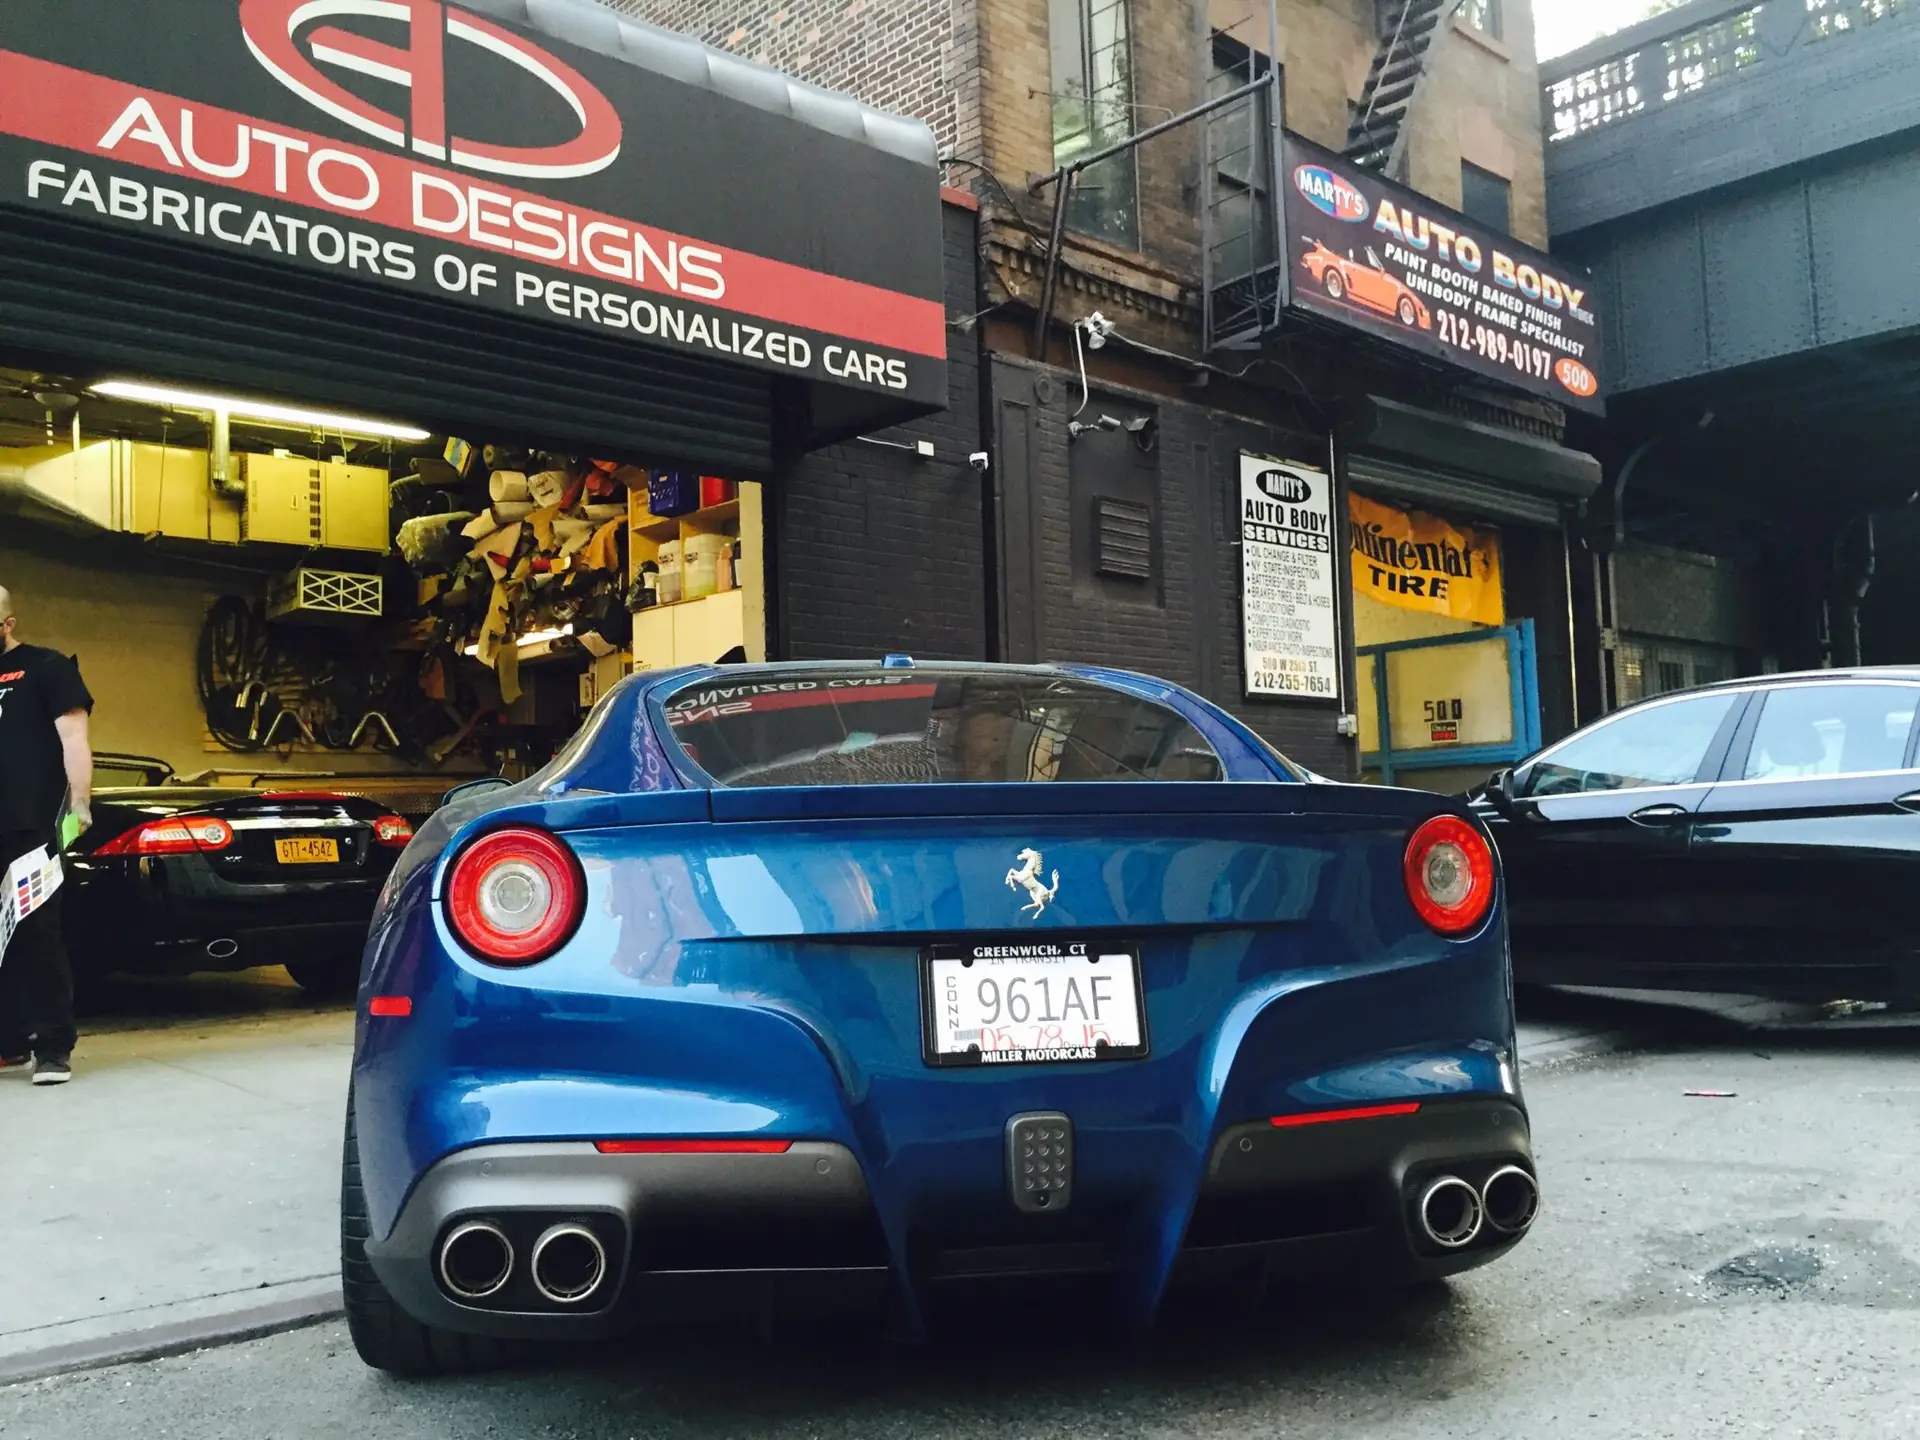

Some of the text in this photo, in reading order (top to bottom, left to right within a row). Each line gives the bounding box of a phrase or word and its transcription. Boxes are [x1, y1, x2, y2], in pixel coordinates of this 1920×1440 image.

[98, 97, 725, 300] AUTO DESIGNS
[1299, 169, 1364, 216] MARTY'S
[28, 160, 907, 390] FABRICATORS OF PERSONALIZED CARS
[1373, 199, 1482, 273] AUTO
[1493, 250, 1584, 318] BODY
[1385, 242, 1562, 331] PAINT BOOTH BAKED FINISH
[1406, 271, 1585, 357] UNIBODY FRAME SPECIALIST
[1437, 309, 1551, 380] 212-989-0197
[1562, 362, 1589, 392] 500
[1266, 472, 1304, 500] MARTY'S
[1245, 499, 1327, 533] AUTO BODY
[1244, 524, 1329, 552] SERVICES
[1263, 547, 1290, 562] CHANGE
[1368, 564, 1449, 600] TIRE
[1262, 656, 1277, 671] 500
[1280, 658, 1287, 671] W
[1254, 671, 1331, 693] 212-255-7654
[1424, 698, 1462, 722] 500
[973, 944, 1087, 957] GREENWICH, CT
[977, 976, 1112, 1025] 961AF
[981, 1047, 1096, 1062] MILLER MOTORCARS
